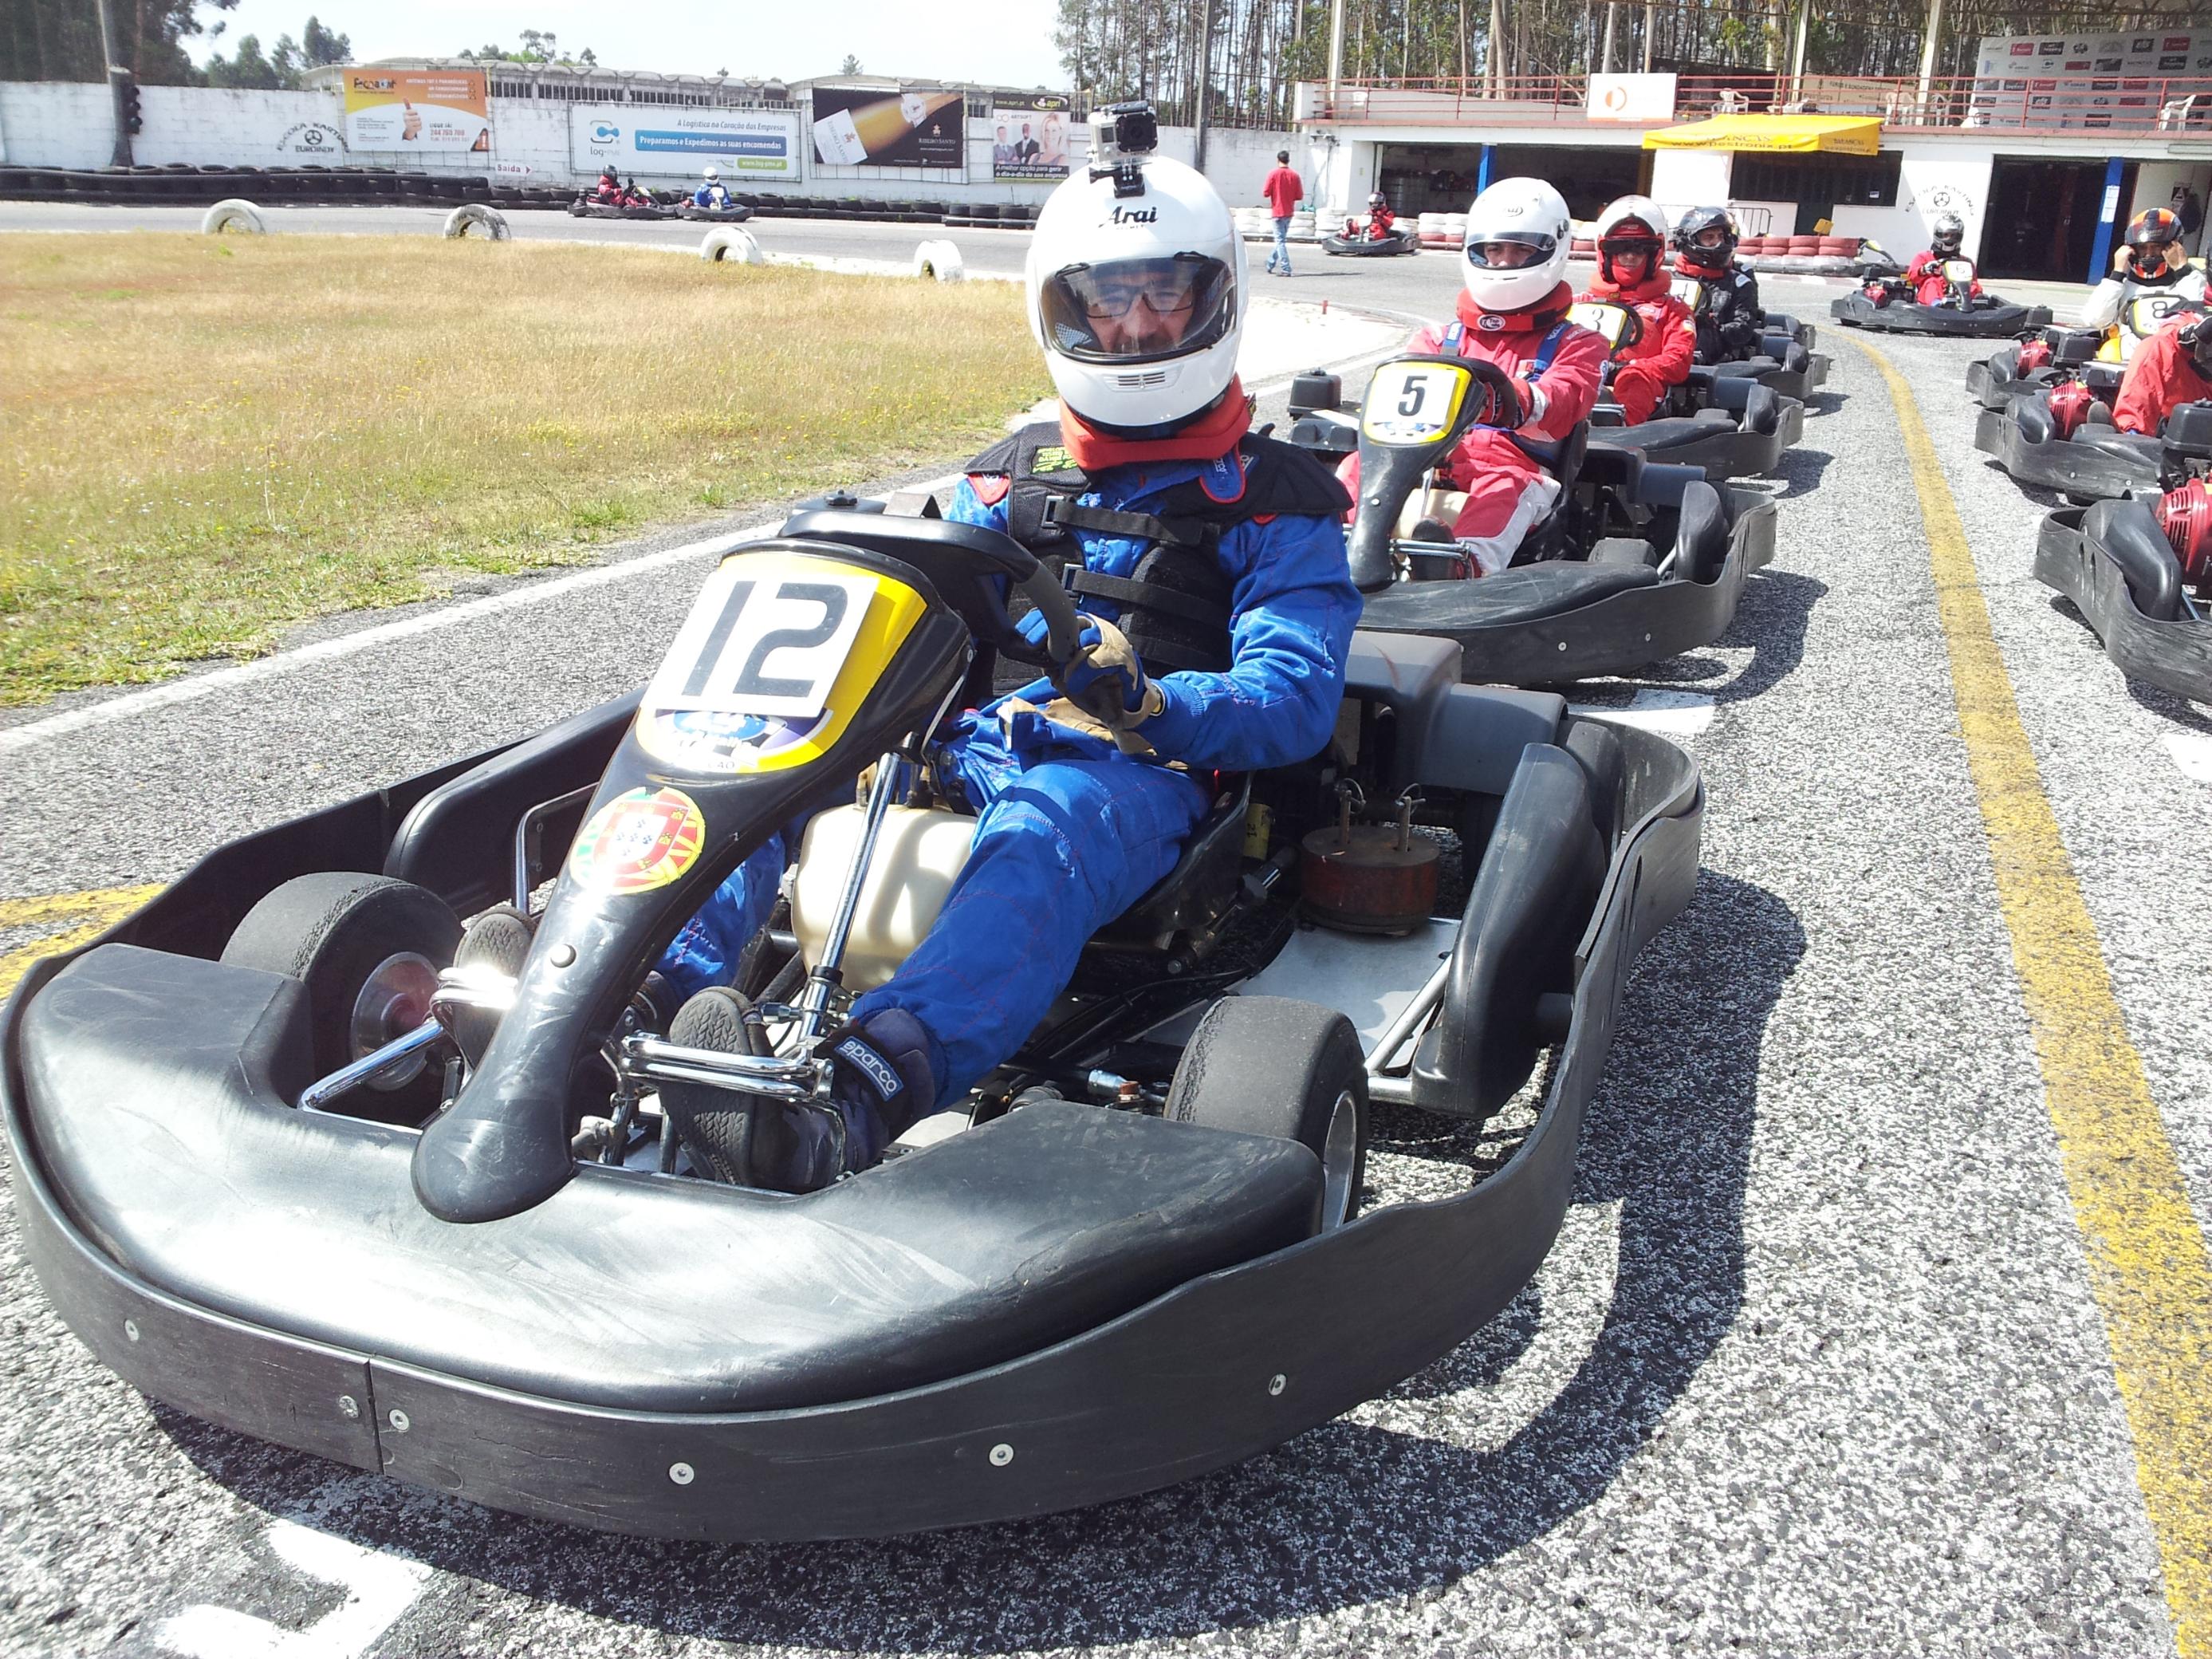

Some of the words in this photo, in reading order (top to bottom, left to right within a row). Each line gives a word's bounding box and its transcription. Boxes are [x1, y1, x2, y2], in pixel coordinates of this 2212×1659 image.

[1046, 99, 1061, 108] apri
[757, 123, 787, 132] Empresas
[640, 136, 679, 147] Preparamos
[684, 137, 718, 148] Expedimos
[742, 140, 782, 150] encomendas
[1098, 205, 1159, 228] Arai
[1592, 308, 1605, 332] 3
[2151, 301, 2167, 319] 8
[1398, 375, 1428, 416] 5
[681, 581, 848, 698] 12
[841, 1040, 898, 1093] sparco
